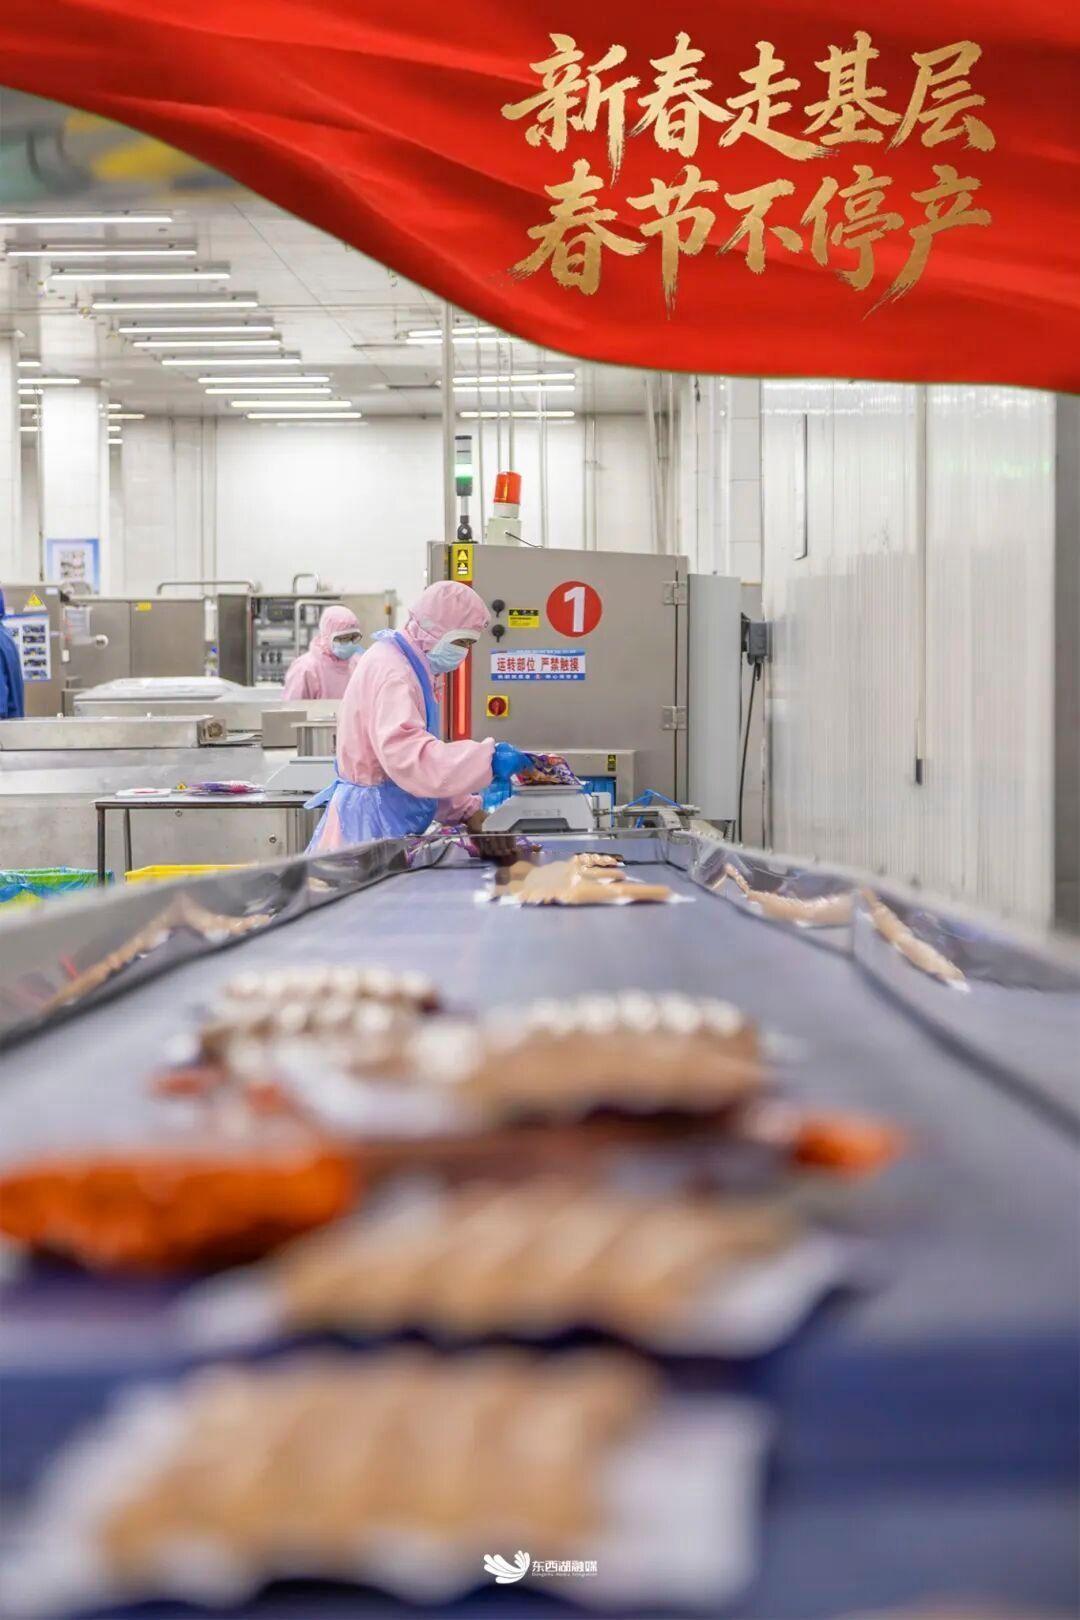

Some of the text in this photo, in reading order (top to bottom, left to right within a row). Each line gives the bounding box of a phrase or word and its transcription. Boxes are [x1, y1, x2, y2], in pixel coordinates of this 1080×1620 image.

[564, 586, 585, 632] 1
[497, 657, 580, 673] 运转部位 严禁触摸
